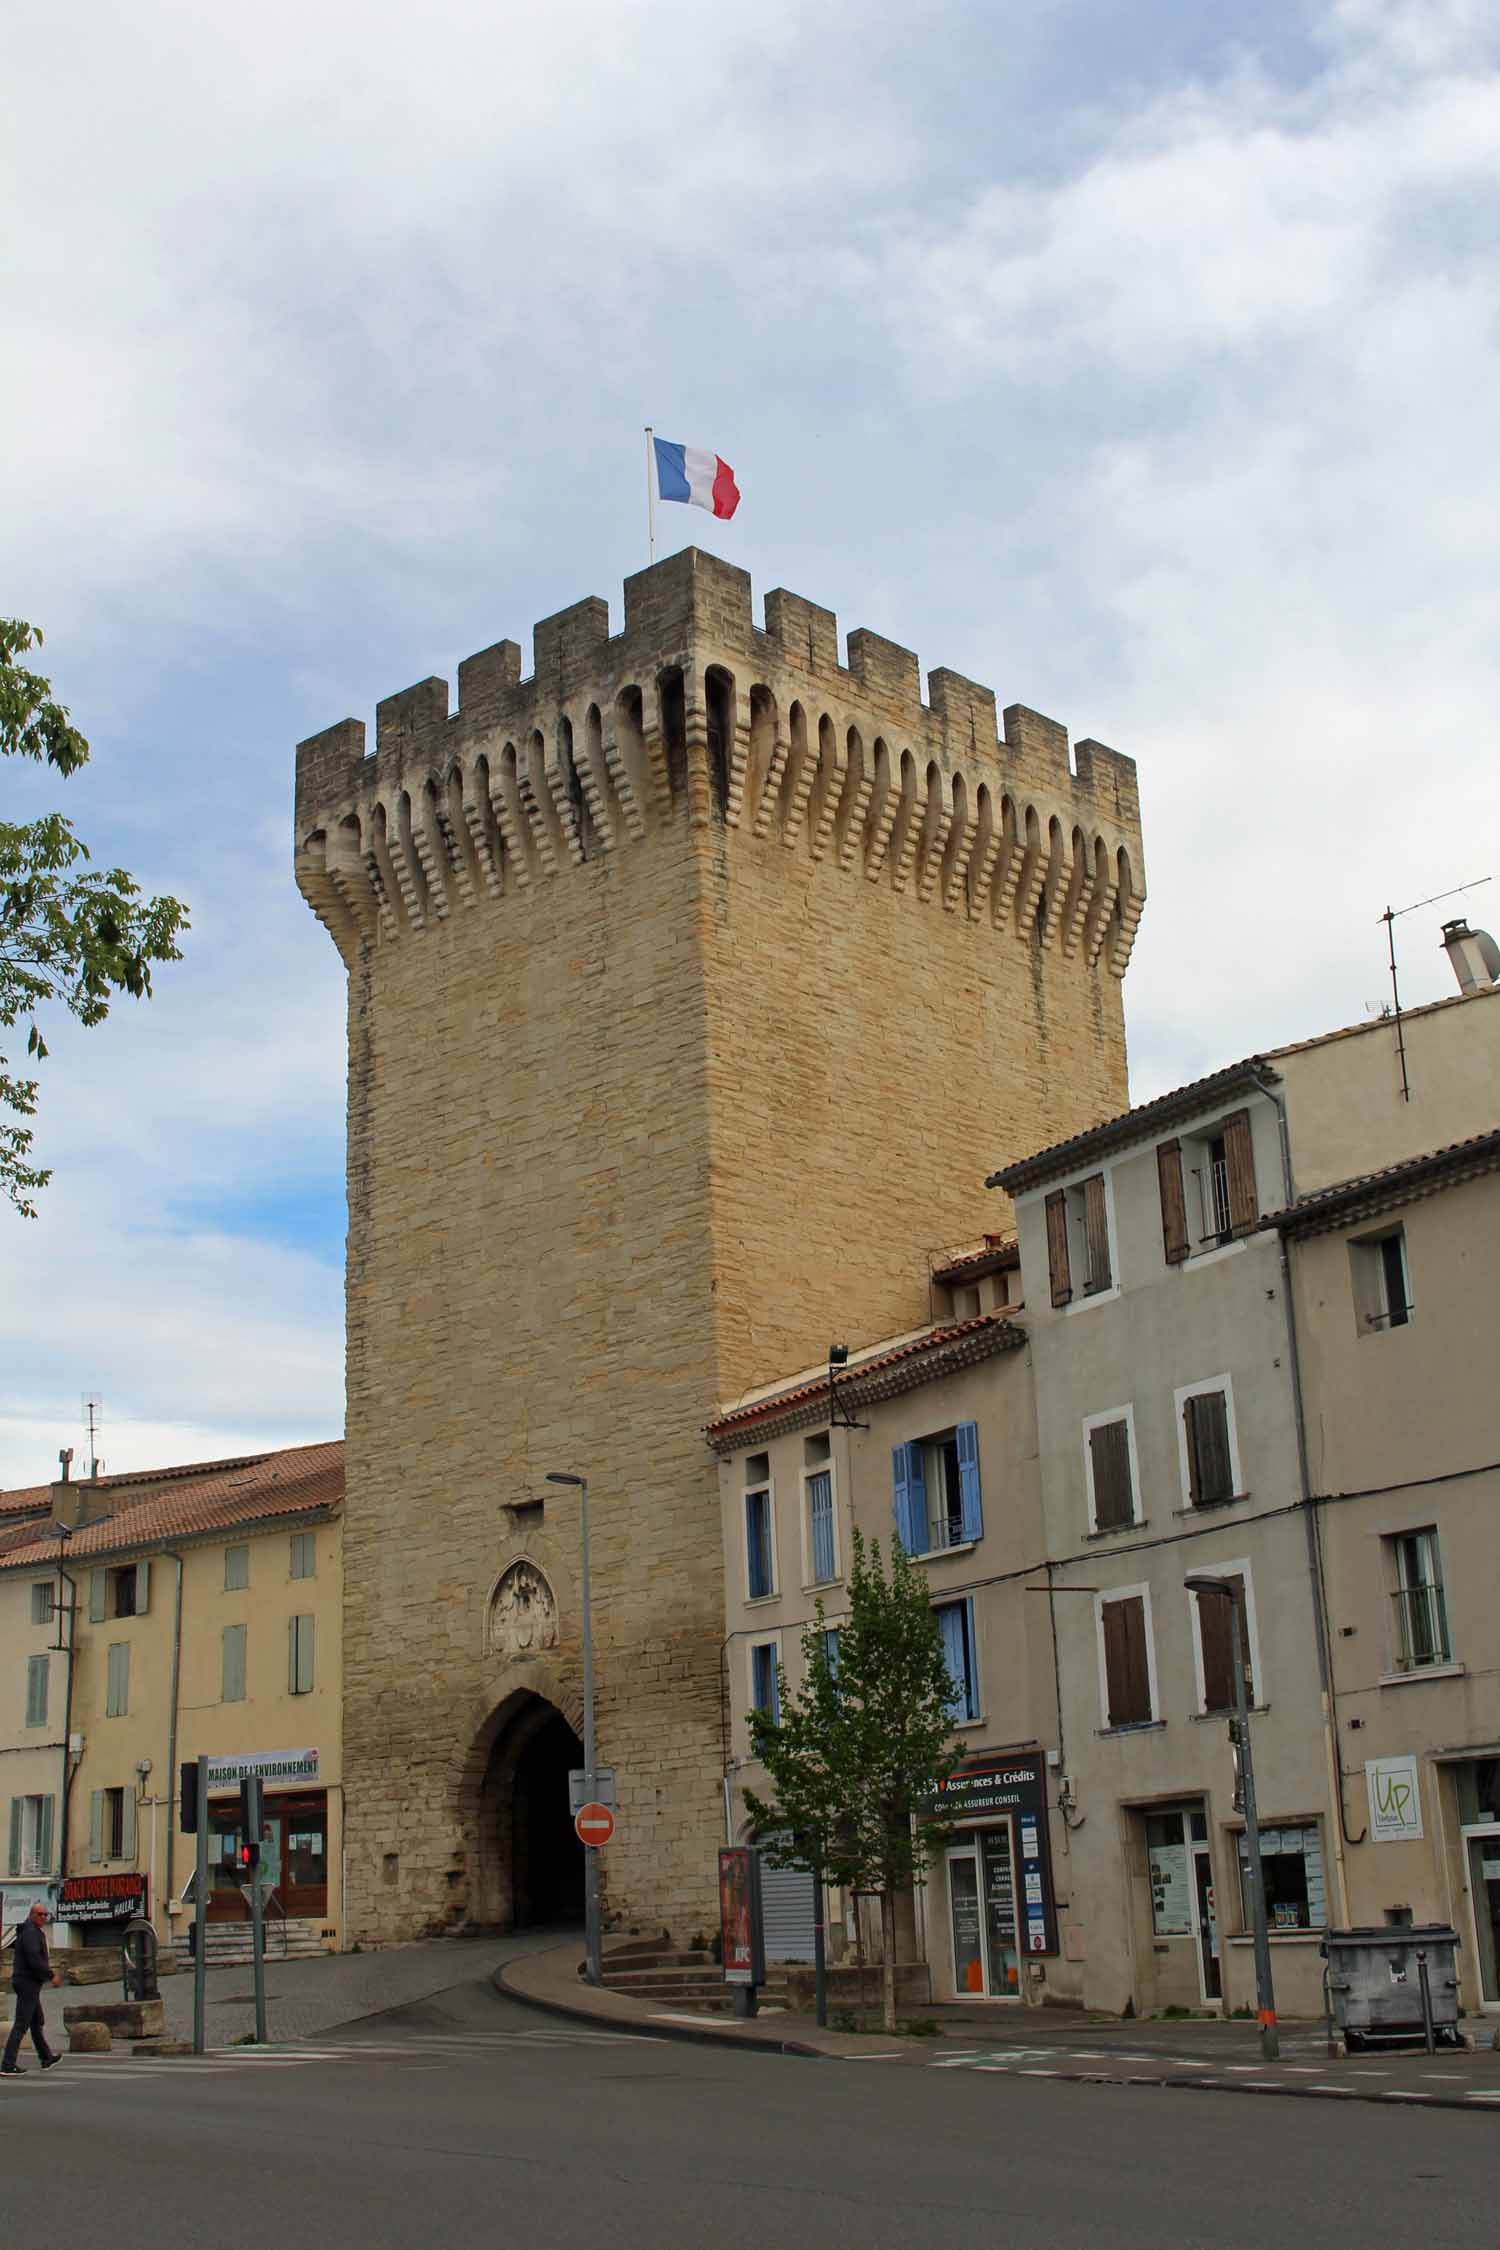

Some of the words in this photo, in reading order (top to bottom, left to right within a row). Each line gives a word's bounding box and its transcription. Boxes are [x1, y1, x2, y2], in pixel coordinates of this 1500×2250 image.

[208, 1767, 237, 1781] MAISON
[239, 1766, 248, 1779] DE
[250, 1759, 318, 1777] L'ENVIRONNEMENT
[994, 1773, 1002, 1785] &
[1003, 1770, 1035, 1784] Crédits
[964, 1797, 993, 1808] ASSUREUR
[995, 1793, 1021, 1805] CONSEIL
